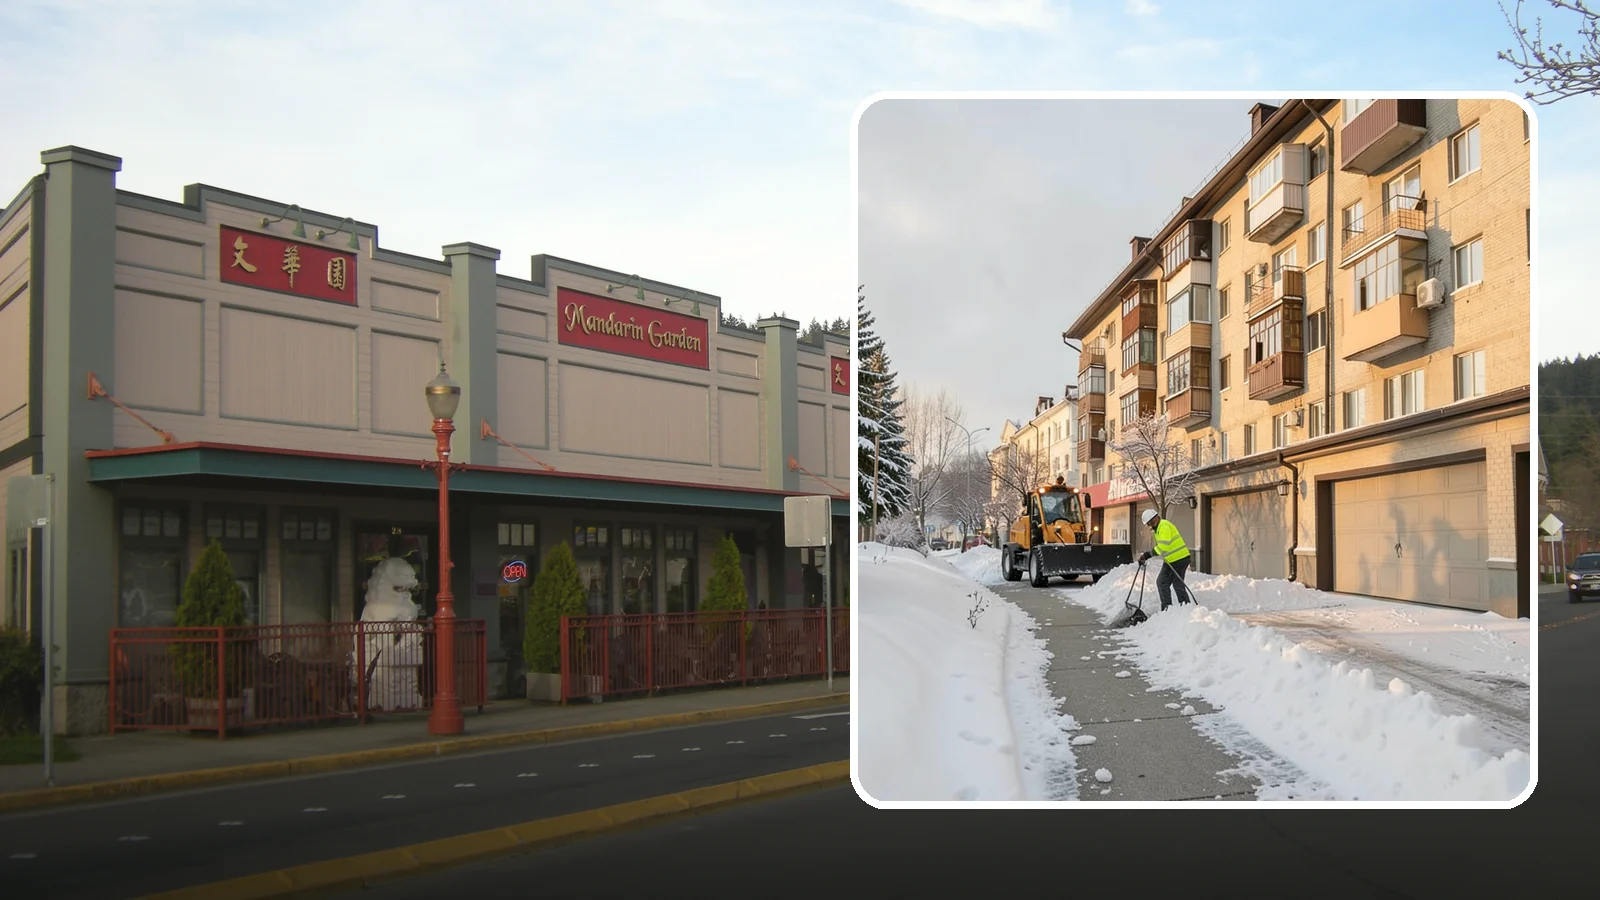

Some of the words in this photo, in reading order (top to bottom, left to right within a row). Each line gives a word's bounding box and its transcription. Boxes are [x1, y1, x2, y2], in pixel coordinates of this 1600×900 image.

[564, 302, 643, 341] Mandarin
[647, 320, 702, 352] Garden
[503, 565, 527, 578] OPEN
